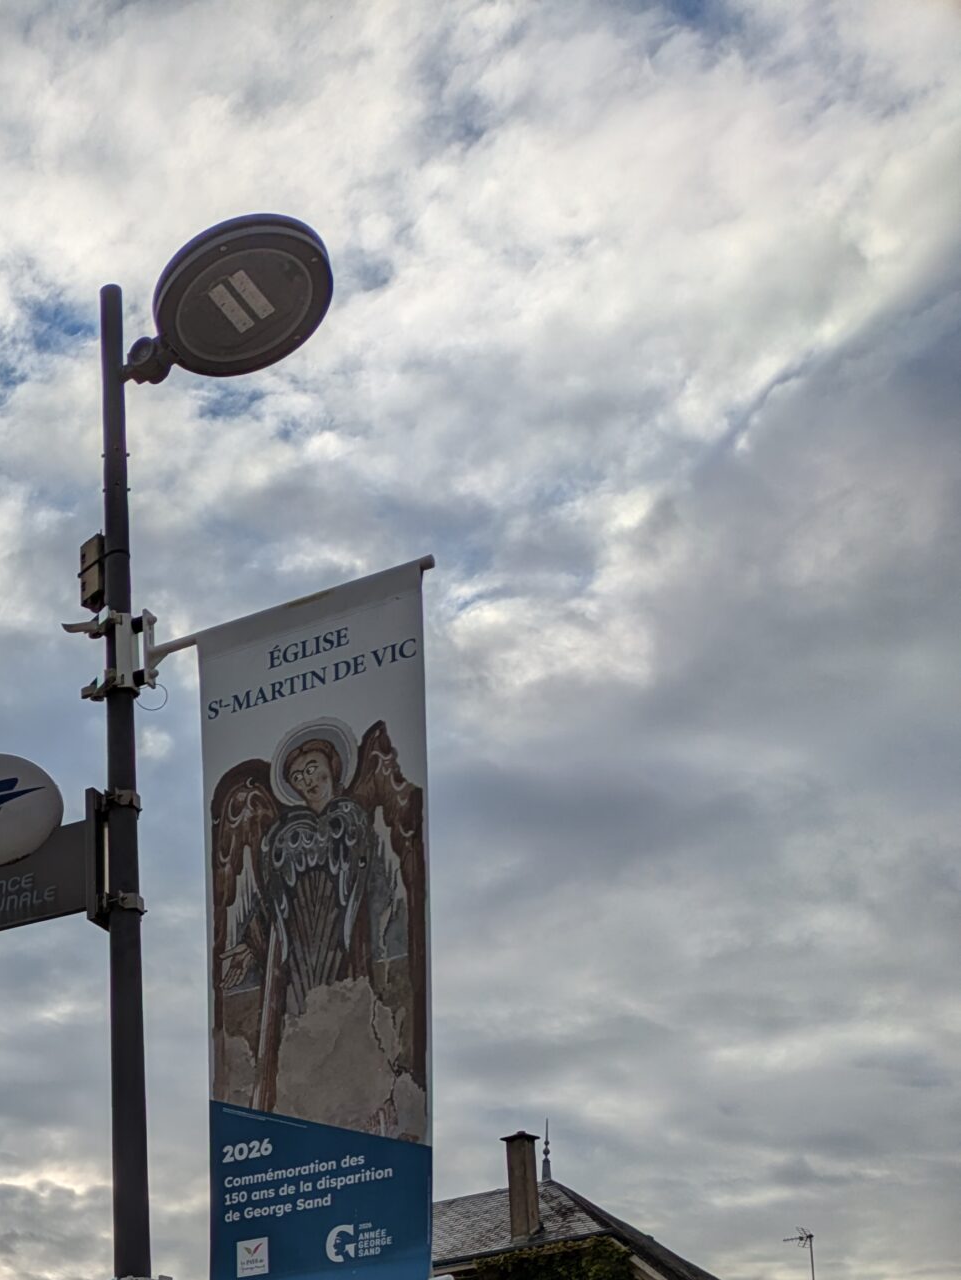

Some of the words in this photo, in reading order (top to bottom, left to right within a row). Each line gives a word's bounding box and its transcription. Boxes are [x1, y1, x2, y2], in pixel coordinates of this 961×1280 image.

[268, 627, 350, 669] ÉGLISE
[332, 655, 366, 682] DE
[370, 638, 417, 668] VIC
[222, 1138, 273, 1163] 2026
[224, 1160, 337, 1188] Commémoration
[340, 1155, 365, 1168] des
[224, 1191, 248, 1206] 150
[251, 1188, 275, 1201] ans
[279, 1183, 296, 1196] de
[299, 1181, 313, 1193] la
[316, 1167, 393, 1190] disparition
[224, 1210, 241, 1223] de
[244, 1203, 292, 1219] George
[296, 1193, 332, 1211] Sand
[358, 1228, 387, 1241] ANNÉE
[358, 1236, 392, 1249] GEORGE
[358, 1246, 381, 1258] SAND
